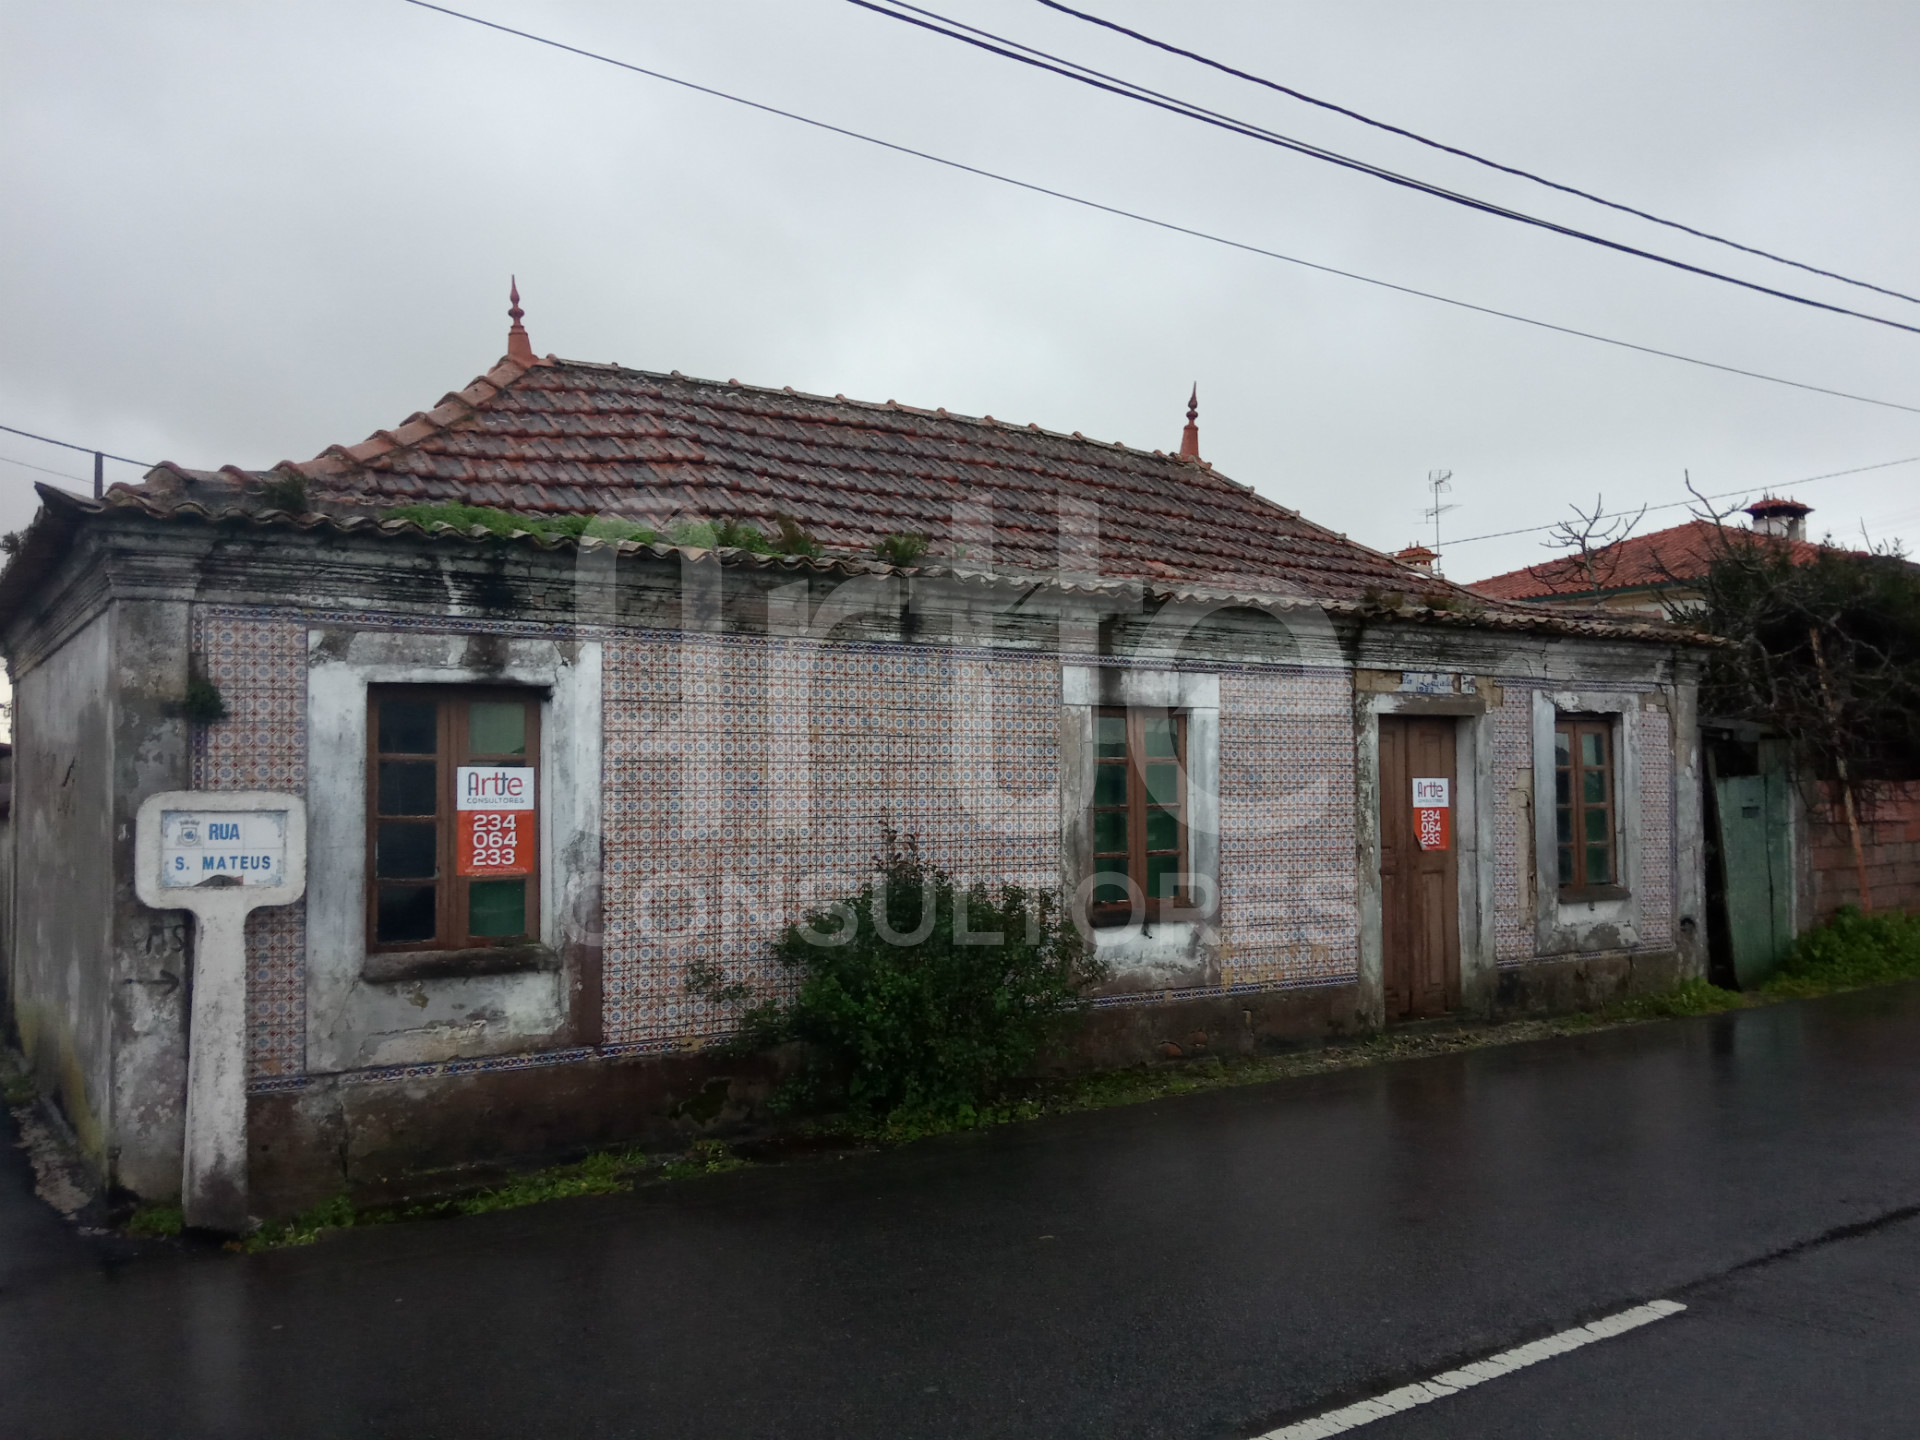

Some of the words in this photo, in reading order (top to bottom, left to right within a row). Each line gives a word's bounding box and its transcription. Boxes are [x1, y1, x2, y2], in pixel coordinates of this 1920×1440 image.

[468, 771, 523, 796] Artte
[1417, 781, 1443, 798] Artte
[473, 814, 516, 831] 234
[1421, 810, 1440, 821] 234
[208, 823, 240, 840] RUA
[1421, 822, 1441, 833] 064
[473, 831, 518, 848] 064
[1421, 833, 1440, 845] 233
[175, 857, 190, 870] S.
[202, 856, 271, 870] MATEUS
[472, 848, 515, 866] 233
